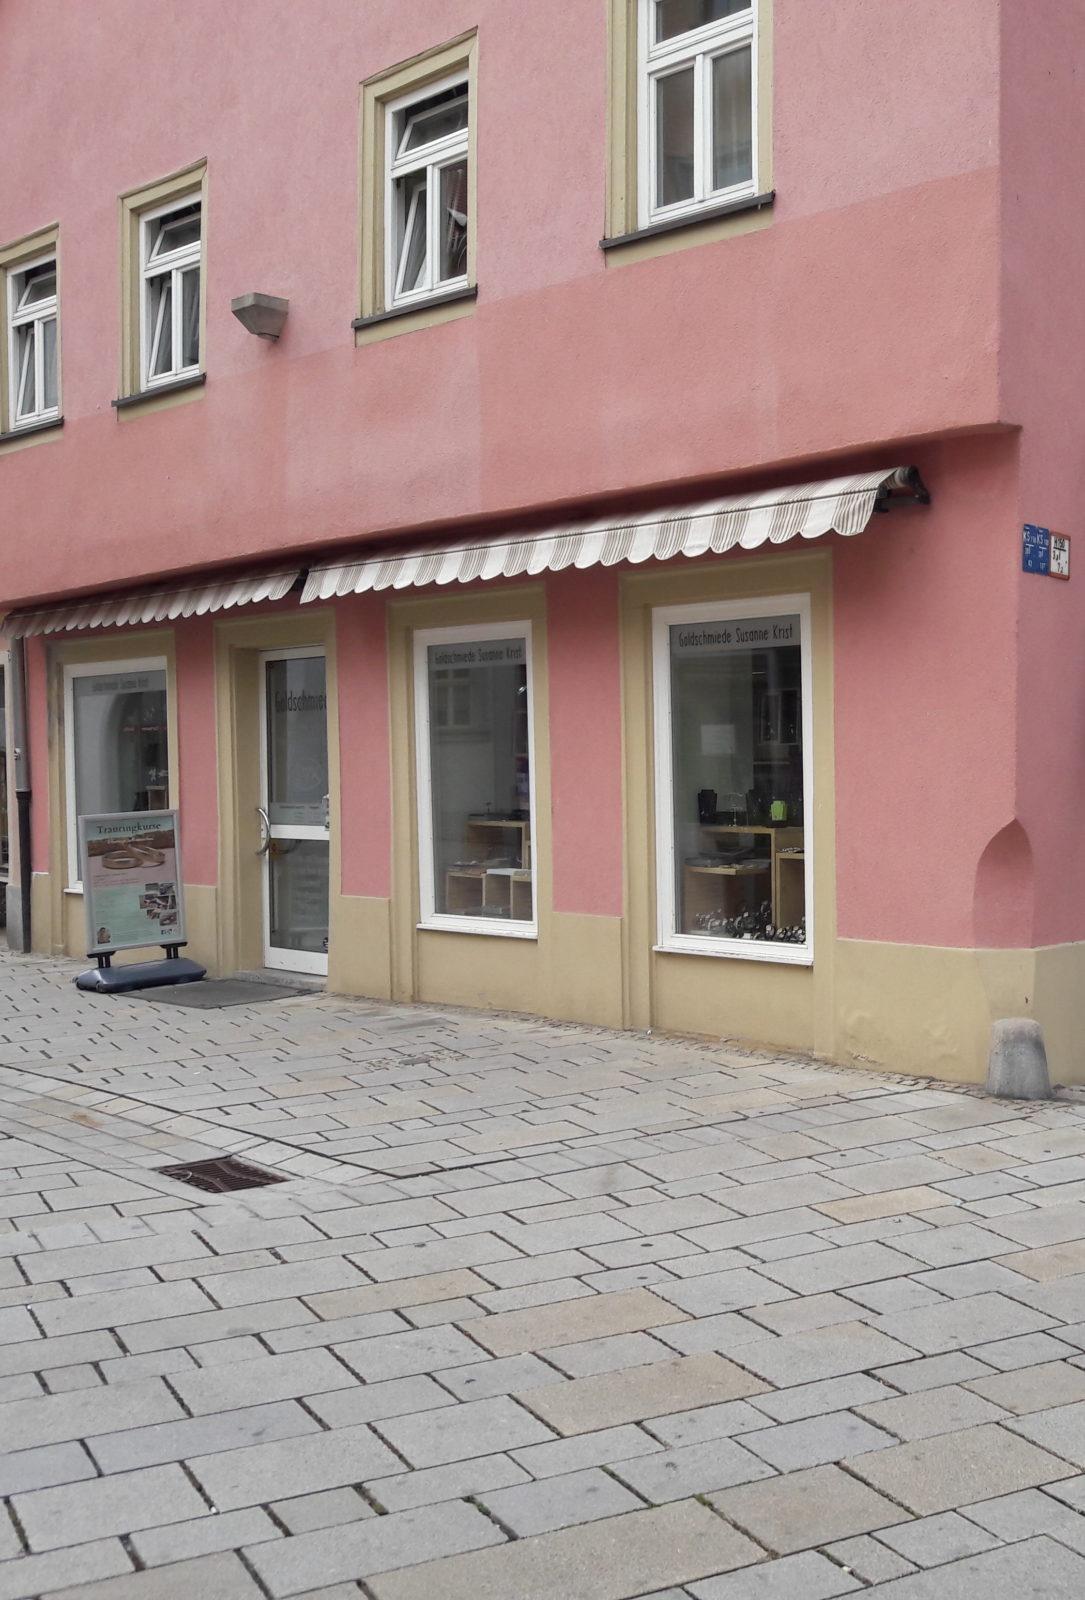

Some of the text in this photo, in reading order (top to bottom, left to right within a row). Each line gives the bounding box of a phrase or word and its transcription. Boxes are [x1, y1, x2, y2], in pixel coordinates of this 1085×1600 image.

[679, 623, 793, 648] Goldschmiede Susanne Krist
[96, 822, 161, 834] Trauringkurse
